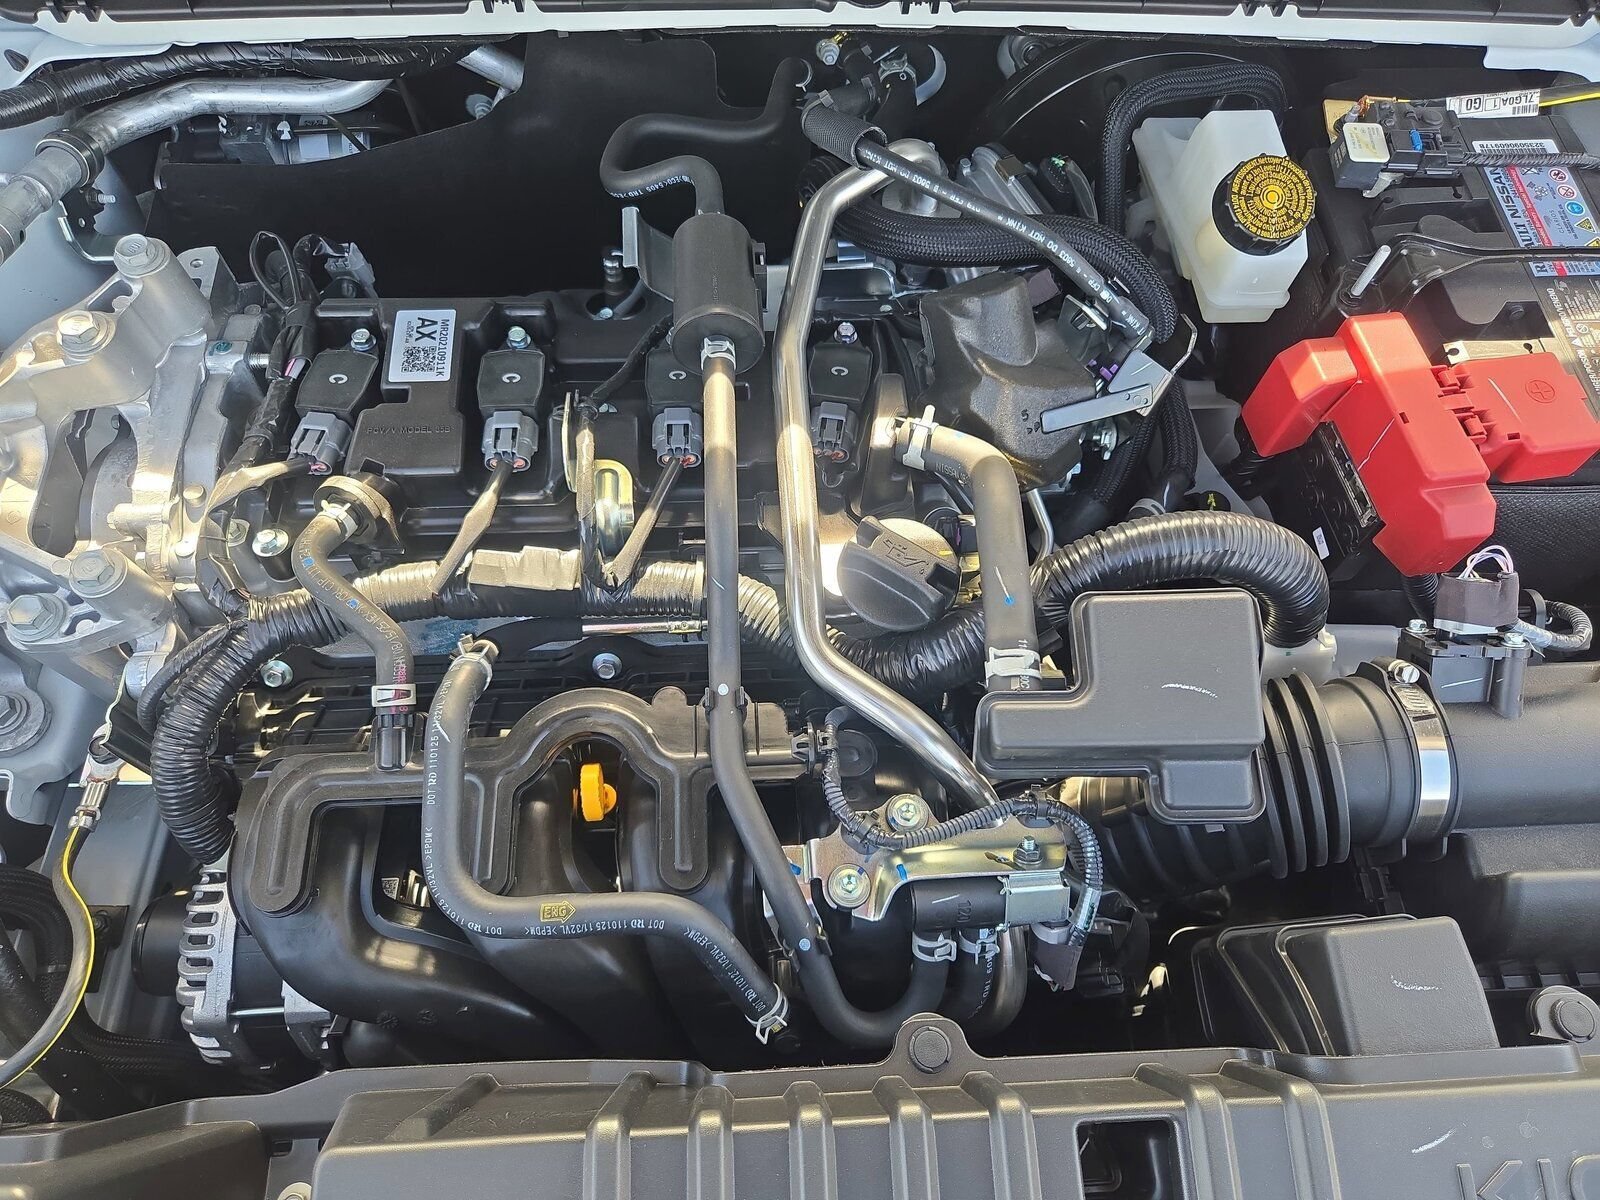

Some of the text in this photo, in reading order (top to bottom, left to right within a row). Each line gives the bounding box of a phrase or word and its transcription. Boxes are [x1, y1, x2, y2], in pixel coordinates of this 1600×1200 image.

[1489, 167, 1522, 220] NISSAN
[1006, 218, 1027, 233] KINK
[1028, 229, 1046, 243] NOT
[1047, 240, 1058, 252] DO
[414, 317, 439, 342] AX
[436, 318, 450, 377] MR20210911K
[401, 426, 433, 435] MODEL
[428, 735, 439, 768] 110125
[427, 791, 436, 805] DOT
[438, 899, 465, 925] 110125
[544, 906, 567, 919] ENG
[485, 926, 502, 936] DOT
[596, 920, 628, 931] 110125
[648, 920, 665, 930] DOT
